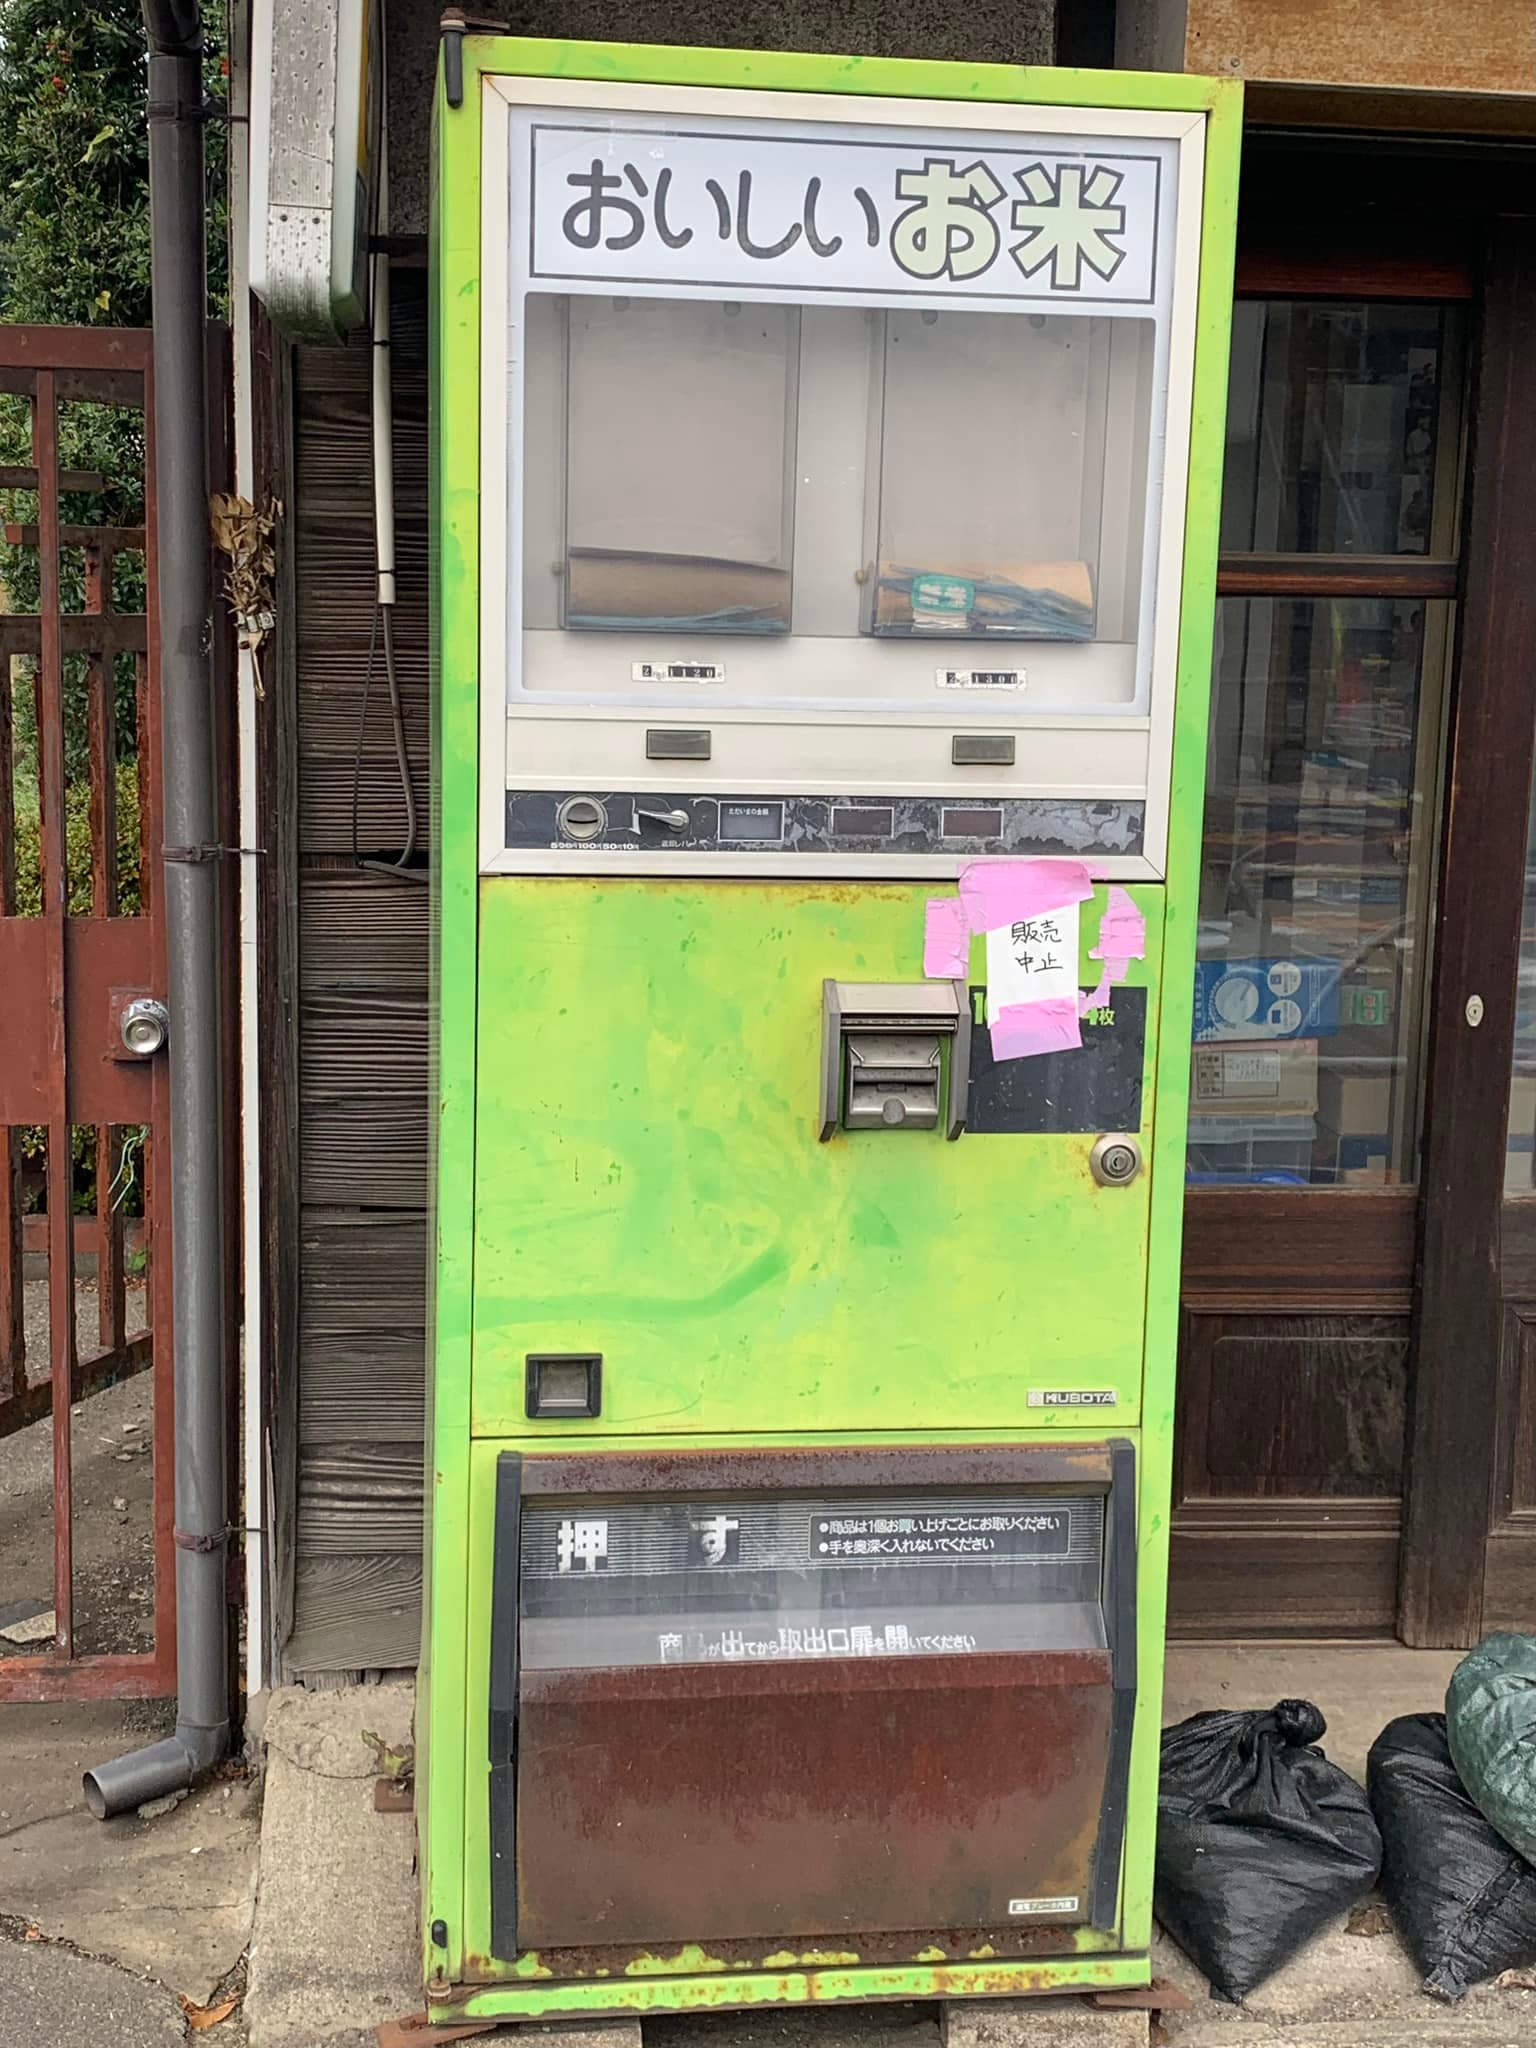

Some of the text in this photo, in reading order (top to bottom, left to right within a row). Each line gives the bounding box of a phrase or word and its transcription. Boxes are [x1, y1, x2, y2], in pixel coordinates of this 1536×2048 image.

[562, 157, 1126, 290] おいしいお米
[1011, 920, 1063, 945] 販売
[1015, 951, 1064, 973] 中止
[1045, 1391, 1114, 1405] KUBOTA
[556, 1515, 739, 1573] 押 す
